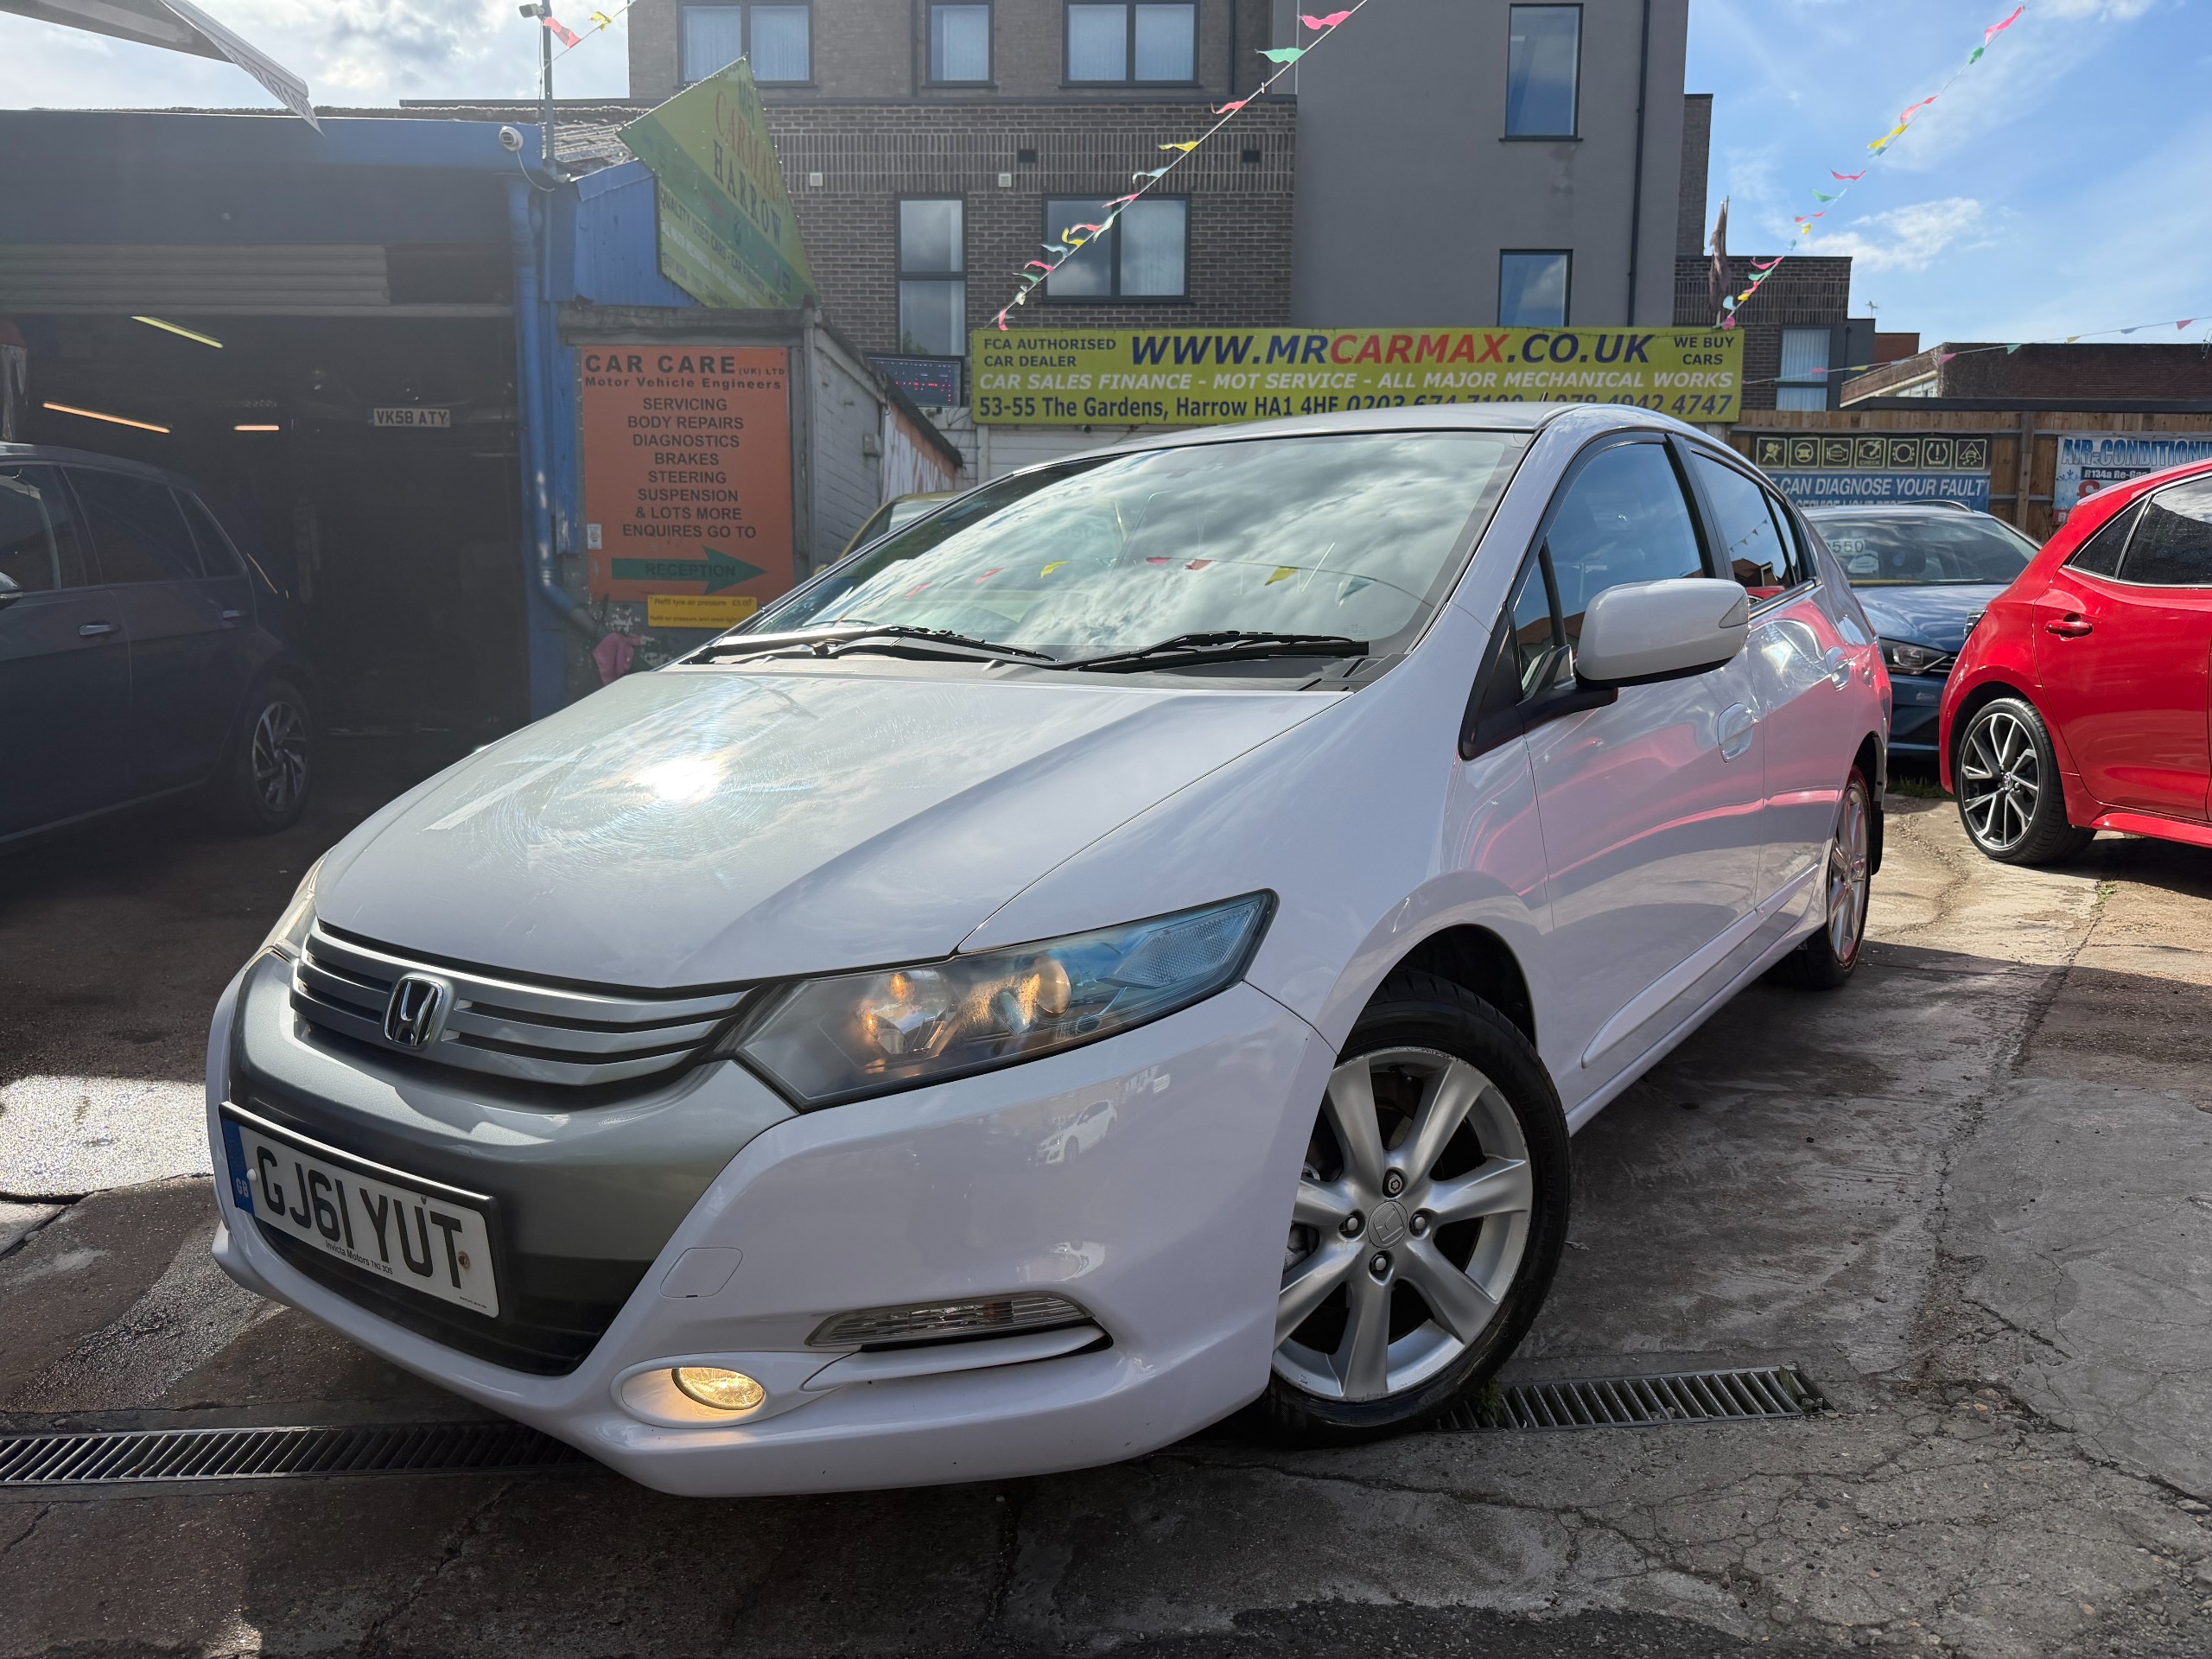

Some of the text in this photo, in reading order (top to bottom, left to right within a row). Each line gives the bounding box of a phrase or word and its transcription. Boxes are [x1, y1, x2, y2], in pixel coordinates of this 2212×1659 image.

[714, 139, 782, 247] HARROW
[983, 338, 1116, 351] FCA AUTHORISED
[1674, 337, 1734, 348] WE BUY
[1132, 334, 1655, 365] WWW.MRCARMAX.CO.UK
[585, 355, 643, 373] CAR
[658, 355, 735, 374] CARE
[984, 355, 1077, 367] CAR DEALER
[1682, 354, 1723, 365] CARS
[585, 378, 781, 391] Motor Vehicle Engineers
[979, 373, 1021, 389] CAR
[1027, 373, 1092, 390] SALES
[1098, 372, 1192, 390] FINANCE
[1213, 373, 1262, 389] MOT
[1264, 372, 1357, 389] SERVICE
[1377, 372, 1415, 389] ALL
[1423, 372, 1496, 389] MAJOR
[1503, 372, 1644, 388] MECHANICAL
[1654, 372, 1733, 388] WORKS
[643, 398, 728, 410] SERVICING
[979, 397, 1035, 417] 53-55
[1042, 397, 1077, 417] The
[1084, 396, 1168, 421] Gardens,
[1177, 397, 1247, 416] Harrow
[1255, 397, 1293, 416] HA1
[1671, 394, 1733, 416] 4747
[376, 410, 448, 425] VK58 ATY
[628, 416, 744, 429] BODY REPAIRS
[632, 435, 740, 448] DIAGNOSTICS
[655, 453, 719, 465] BRAKES
[648, 471, 727, 484] STEERING
[2084, 469, 2113, 479] R134a
[1782, 479, 1812, 495] CAN
[1815, 479, 1891, 496] DIAGNOSE
[1897, 480, 1940, 495] YOUR
[1939, 480, 1983, 497] FAULT
[638, 489, 739, 502] SUSPENSION
[636, 507, 742, 520] & LOTS MORE
[623, 524, 756, 538] ENQUIRES GO TO
[645, 563, 736, 577] RECEPTION
[236, 1178, 249, 1198] GB
[257, 1146, 462, 1289] GJ61 YUT
[326, 1240, 346, 1255] Invicta
[347, 1249, 370, 1266] Motors
